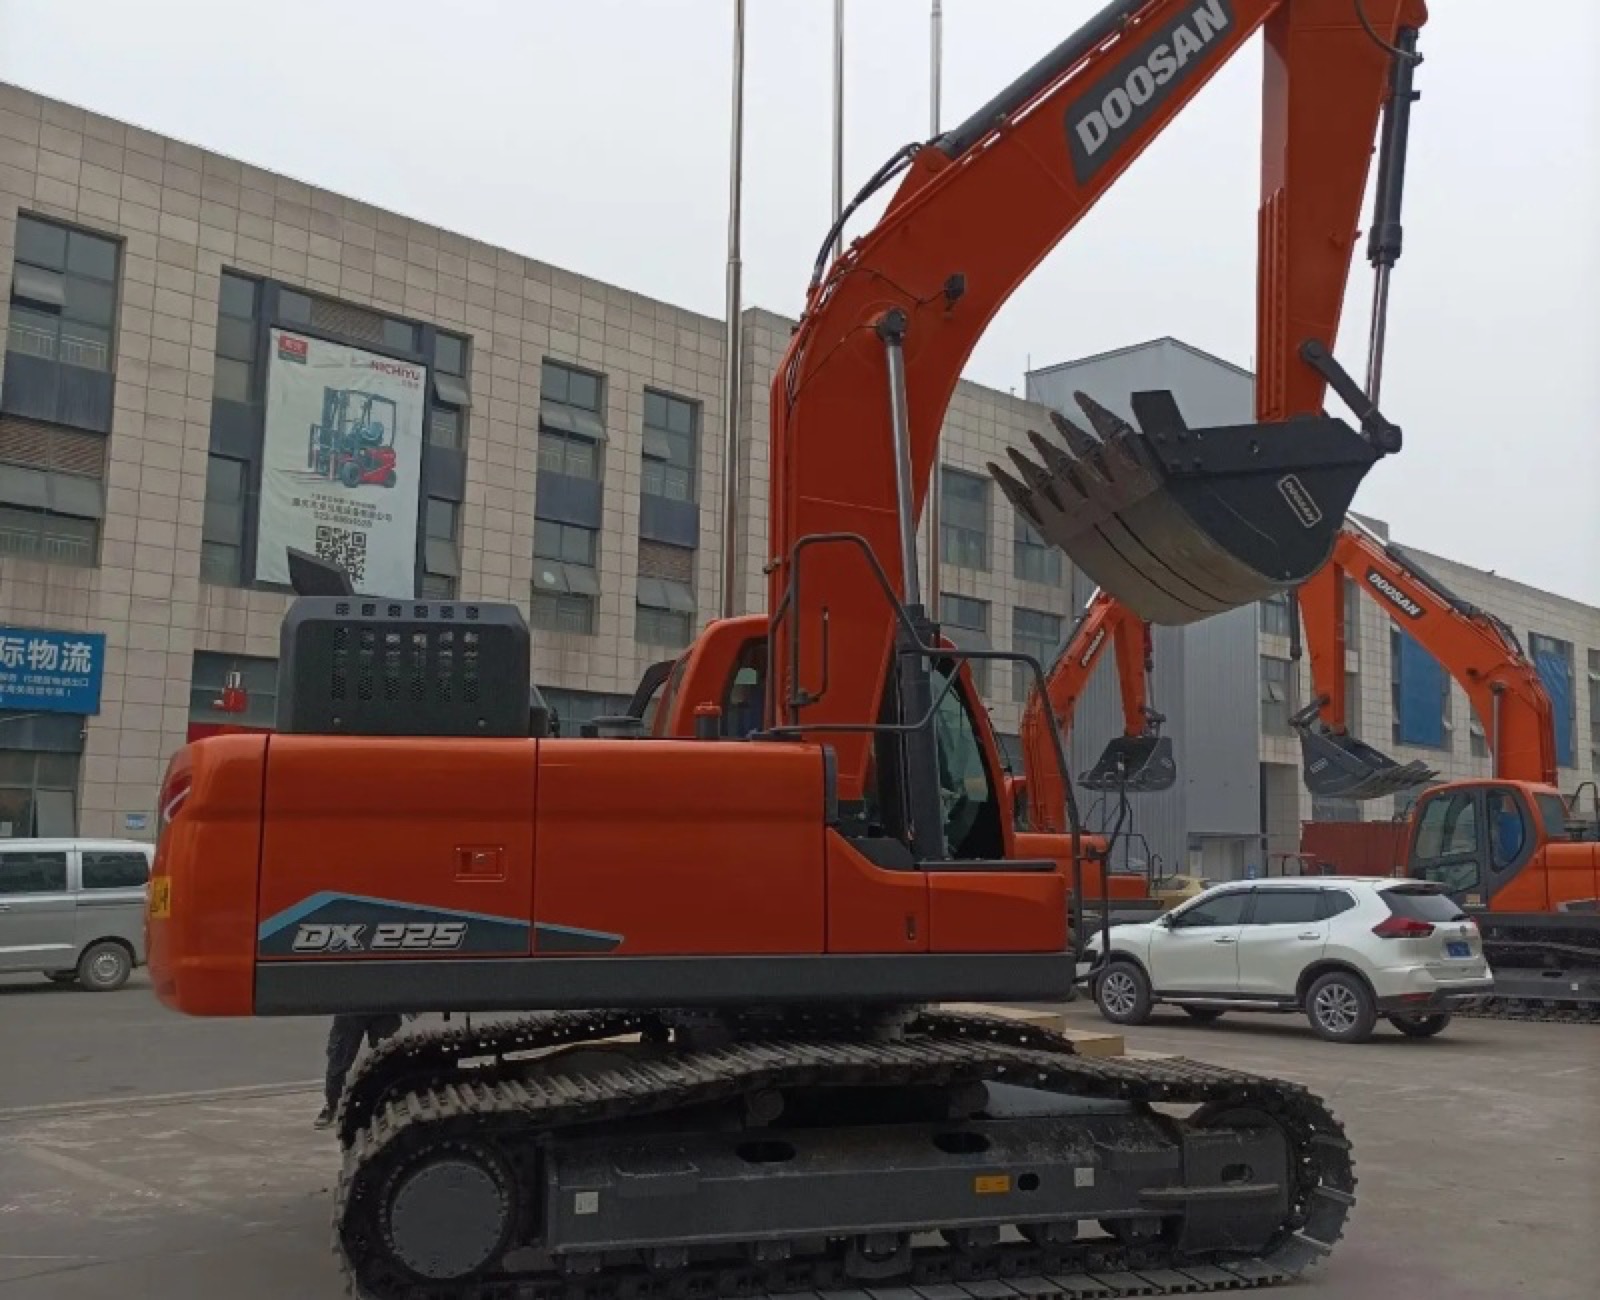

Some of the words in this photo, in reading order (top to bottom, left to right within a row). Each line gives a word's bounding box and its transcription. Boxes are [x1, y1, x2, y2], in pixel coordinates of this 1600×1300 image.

[1075, 0, 1229, 157] DOOSAN
[369, 359, 421, 381] NICHIYU
[1369, 573, 1421, 616] DOOSAN
[292, 923, 367, 952] DX
[370, 922, 469, 950] 225
